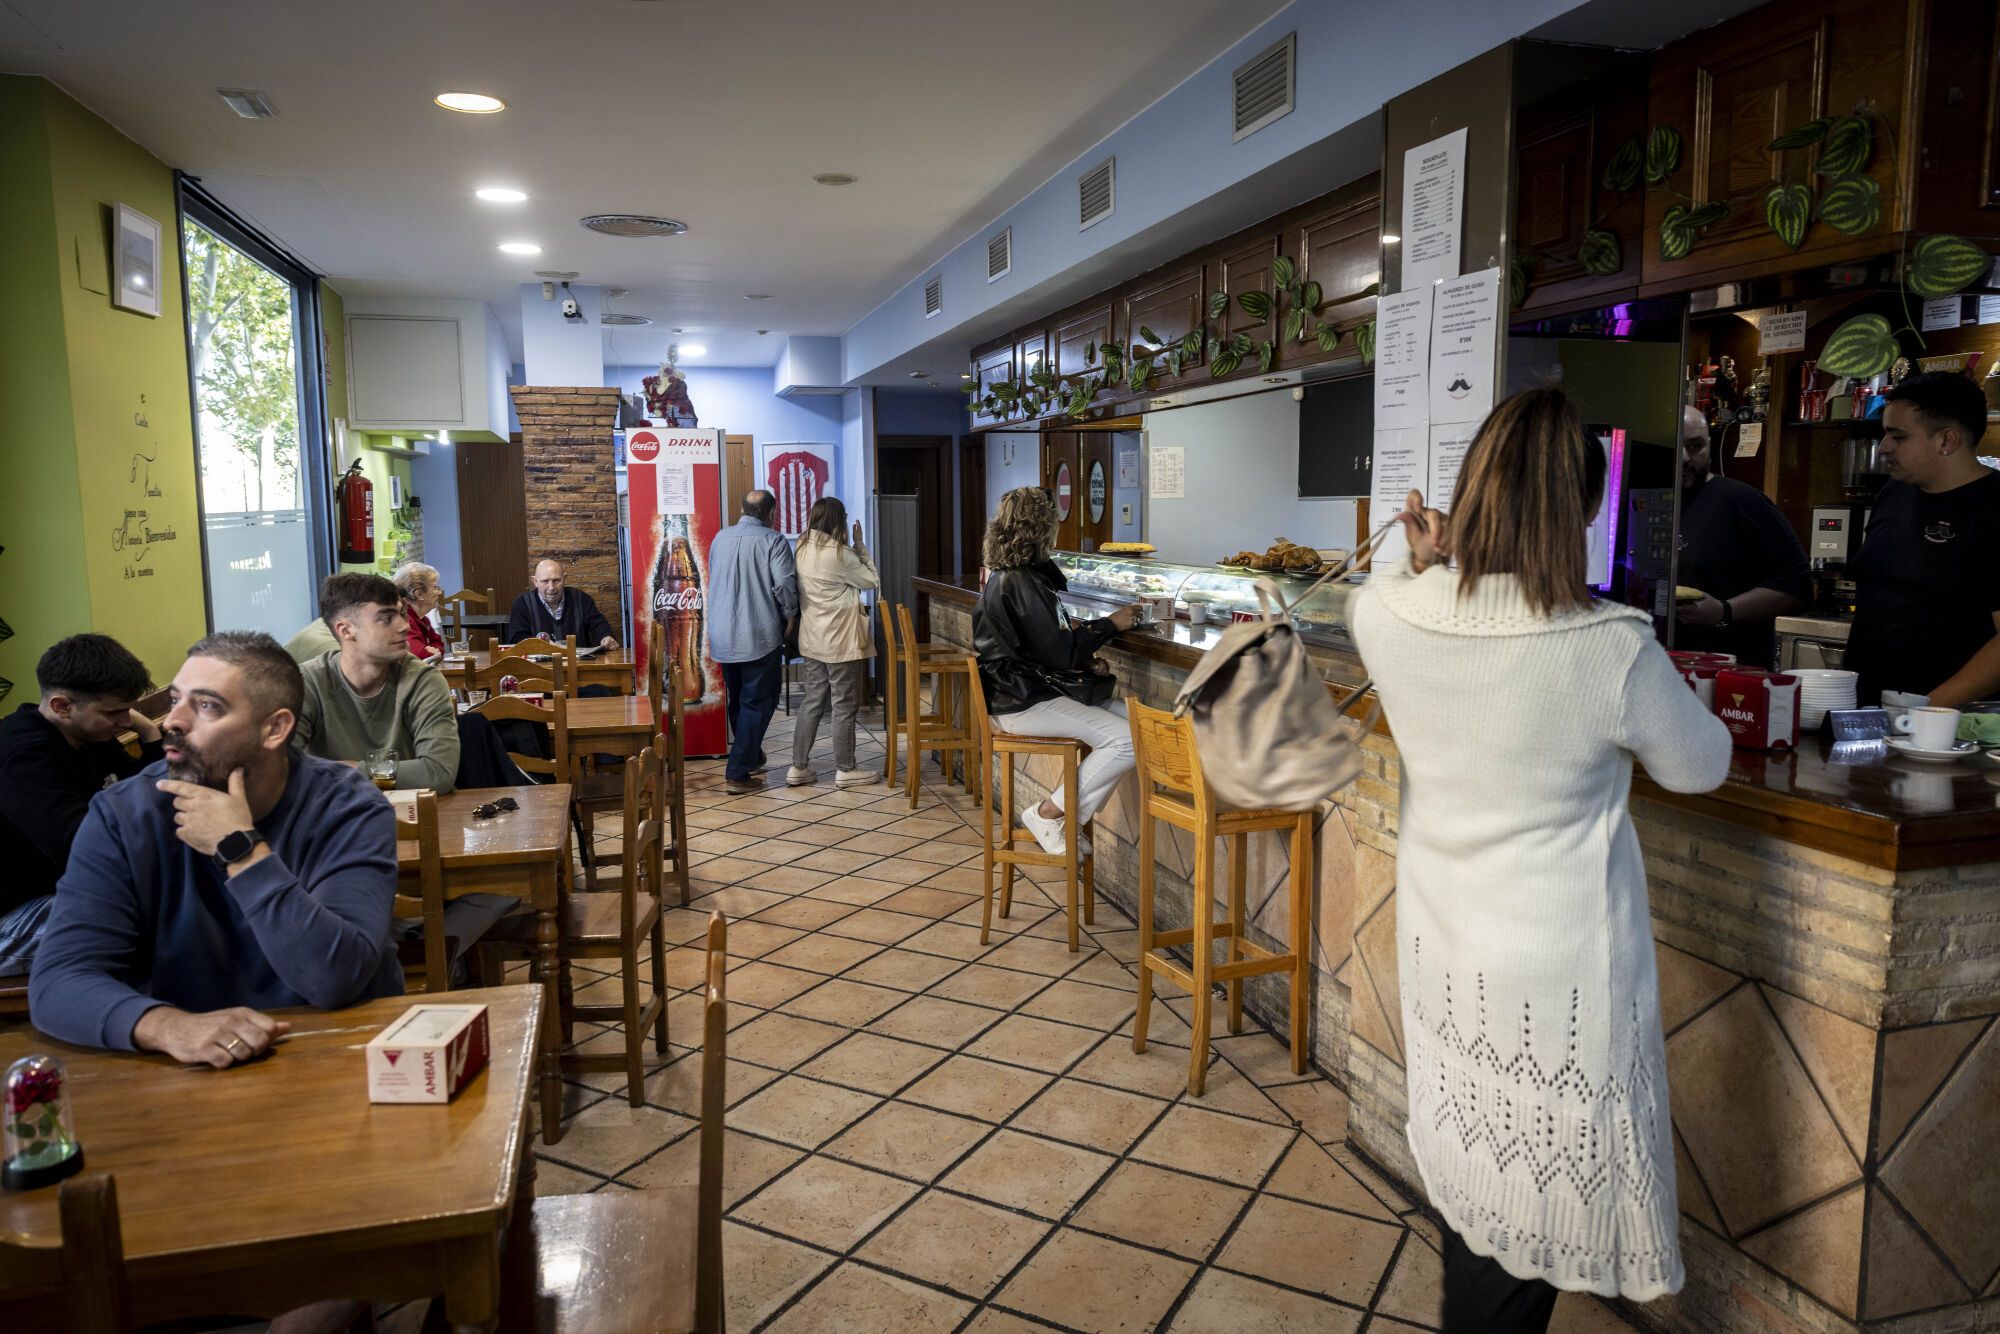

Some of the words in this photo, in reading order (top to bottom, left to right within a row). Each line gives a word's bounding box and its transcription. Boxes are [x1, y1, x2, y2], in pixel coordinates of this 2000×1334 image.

[1769, 314, 1803, 325] RESERVADO
[1773, 322, 1802, 331] DERECHO
[1924, 359, 1960, 373] AMBAR
[631, 441, 659, 451] Coca-Cola
[667, 438, 713, 447] DRINK
[144, 524, 177, 544] Bienvenidos
[653, 587, 703, 612] Coca-Cola
[1720, 708, 1754, 723] AMBAR
[423, 1050, 437, 1096] AMBAR
